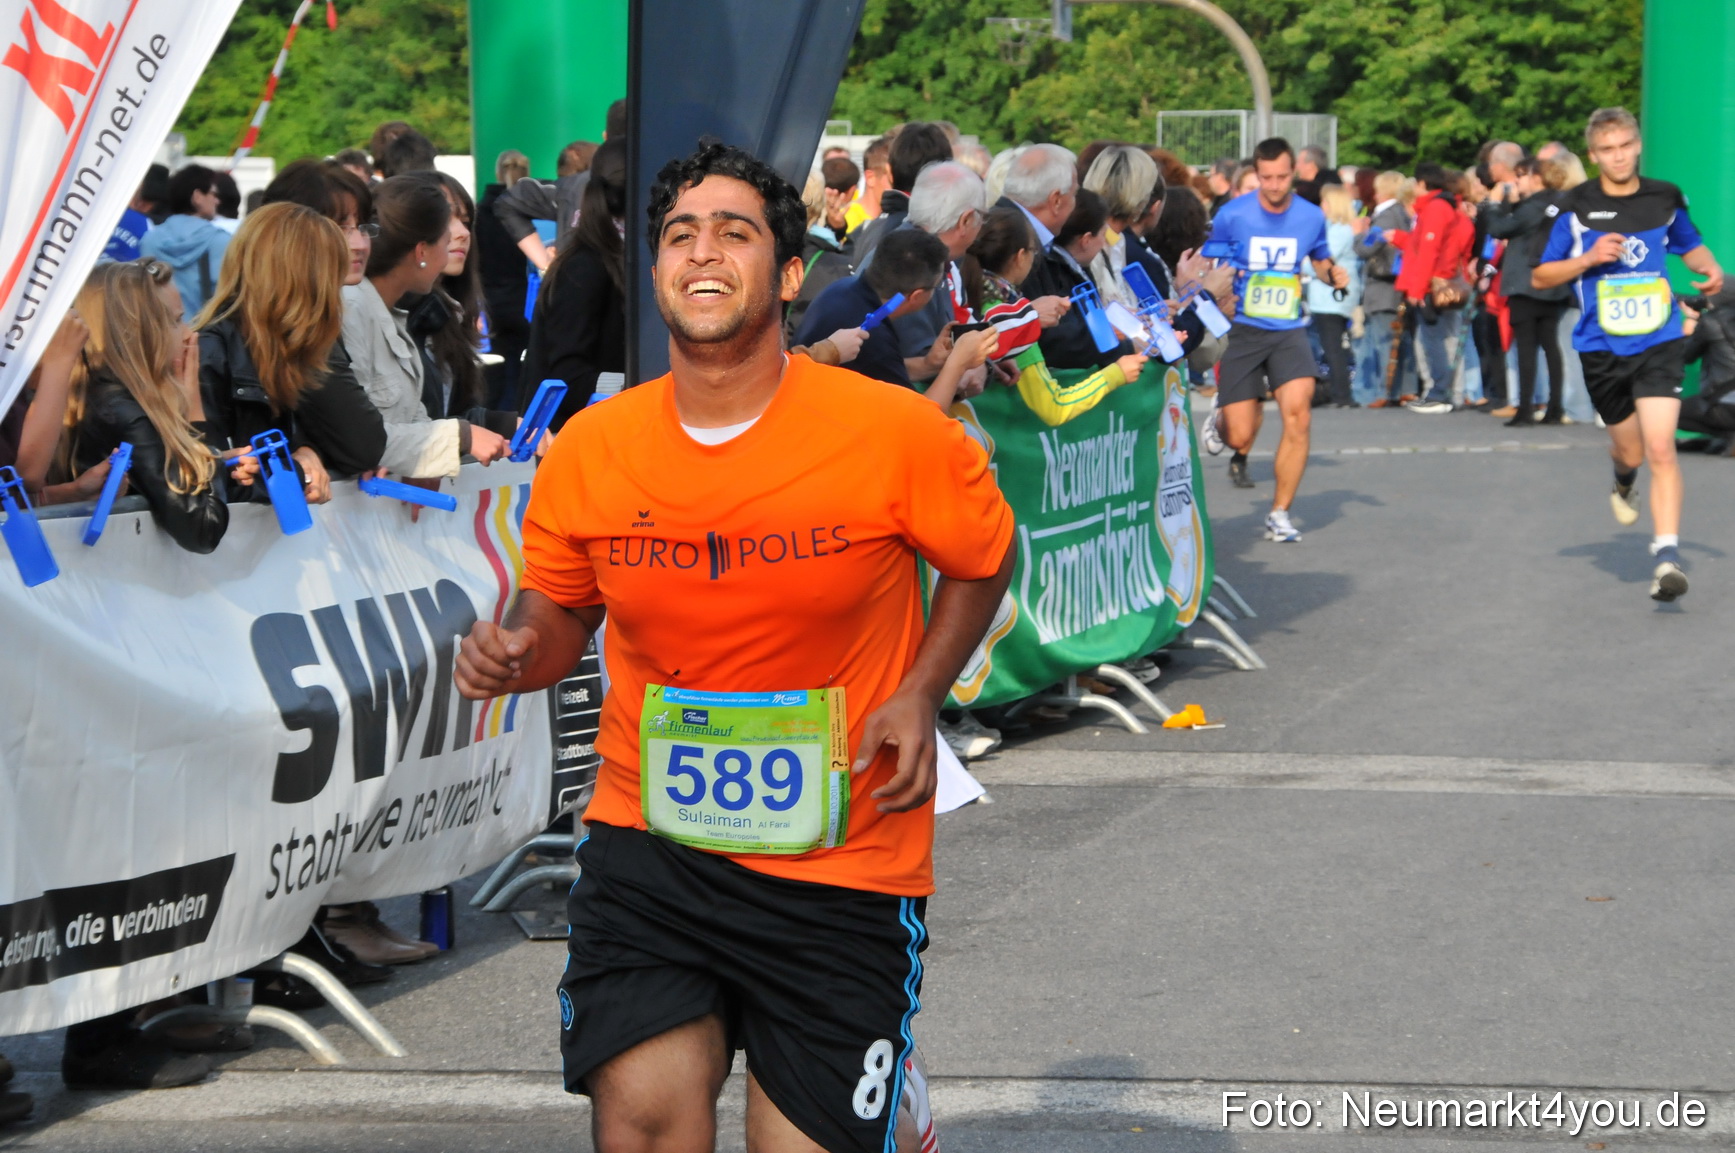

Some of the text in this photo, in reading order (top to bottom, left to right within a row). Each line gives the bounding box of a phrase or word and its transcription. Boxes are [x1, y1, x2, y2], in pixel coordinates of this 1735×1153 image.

[1251, 287, 1288, 306] 910
[1608, 297, 1653, 321] 301
[1038, 411, 1138, 514] Neumarkter
[632, 520, 655, 528] erima
[1018, 500, 1166, 646] Lammsbräu
[669, 720, 735, 737] firmenlauf
[665, 744, 804, 811] 589
[678, 808, 752, 829] Sulaiman
[706, 830, 760, 841] Team Europoles
[65, 911, 106, 949] die
[111, 892, 209, 942] verbinden
[852, 1038, 894, 1121] 8
